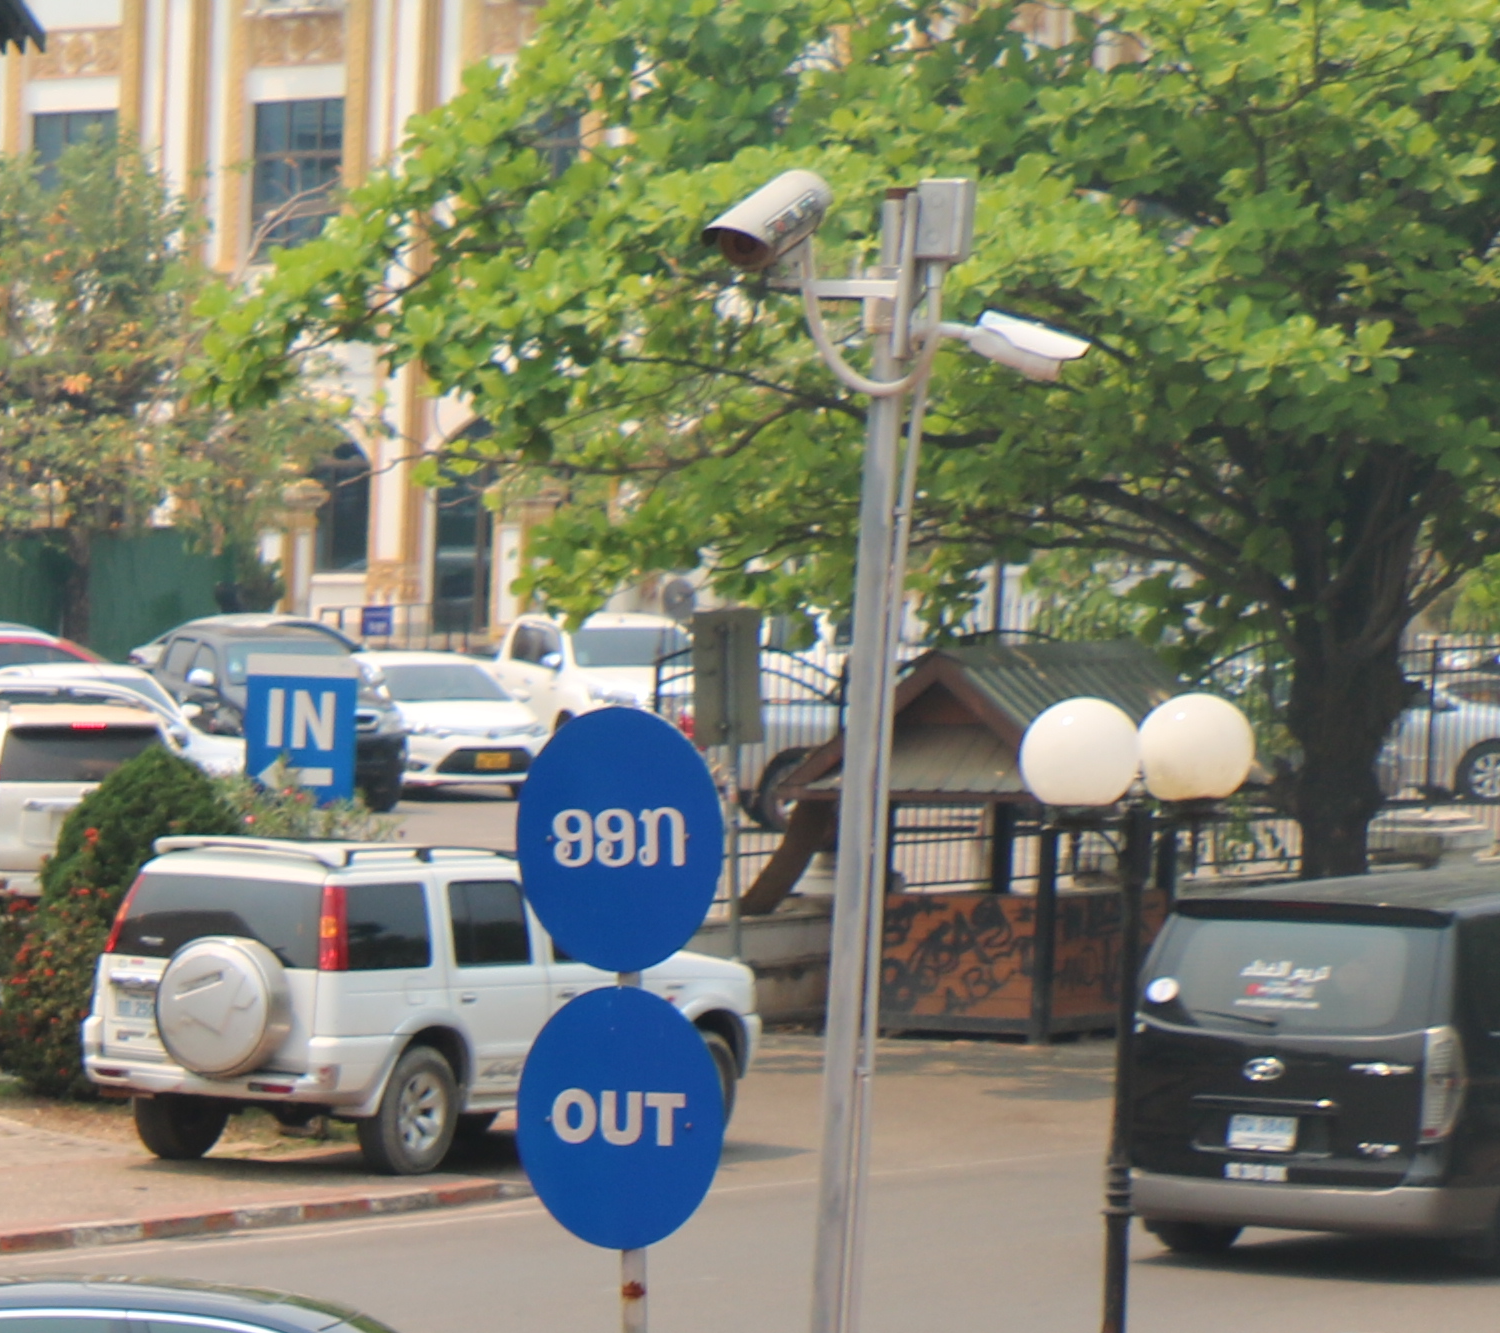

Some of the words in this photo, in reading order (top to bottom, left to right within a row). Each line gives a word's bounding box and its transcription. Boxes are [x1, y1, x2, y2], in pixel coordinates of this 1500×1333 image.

[266, 687, 336, 751] IN
[552, 806, 686, 868] ອອກ
[551, 1088, 686, 1146] OUT
